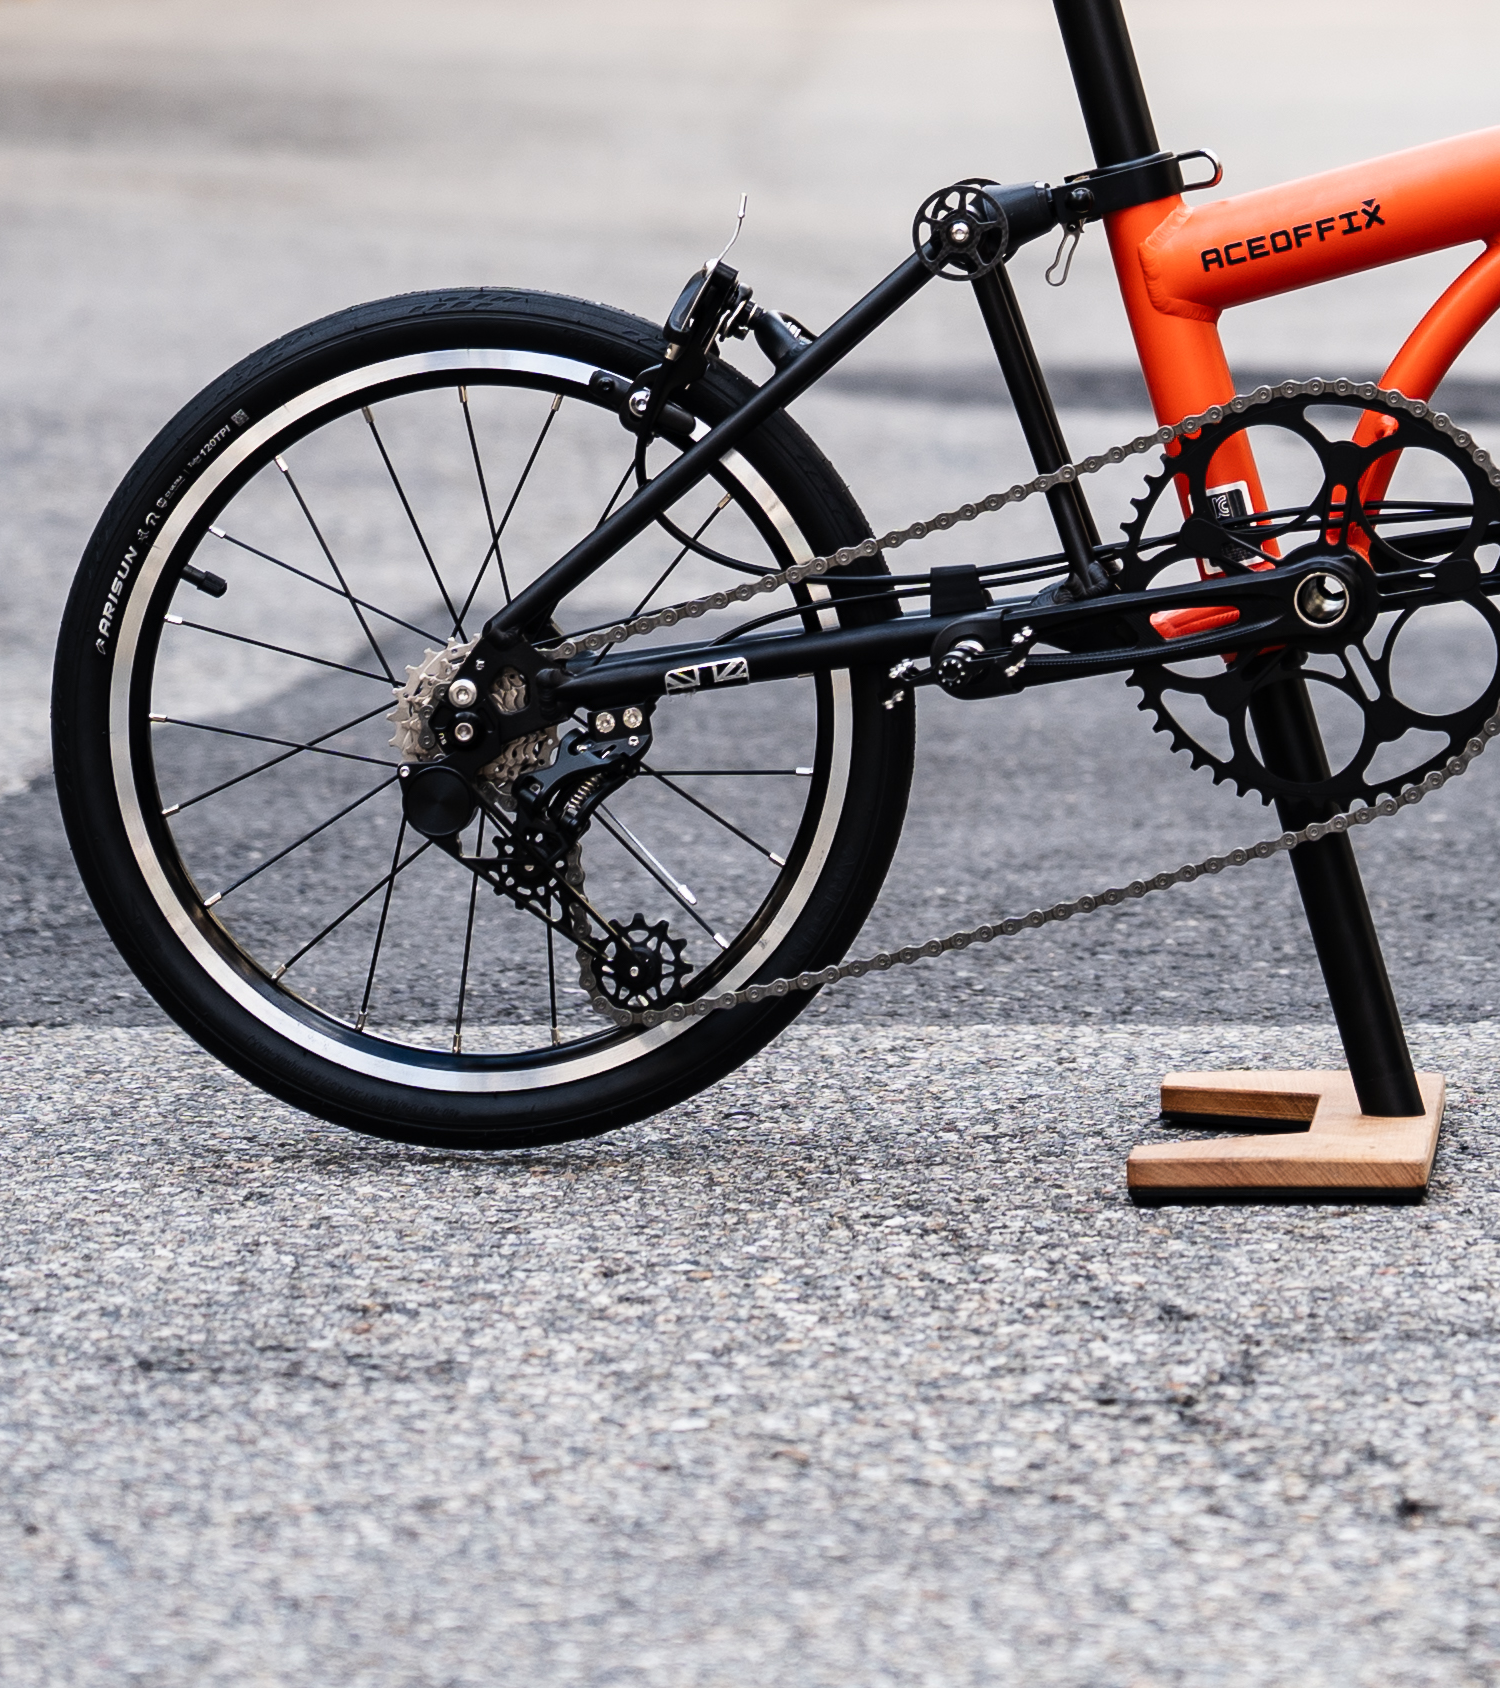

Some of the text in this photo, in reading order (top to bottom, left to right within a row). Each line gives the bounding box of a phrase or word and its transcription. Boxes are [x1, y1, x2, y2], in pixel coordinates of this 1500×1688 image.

[1200, 198, 1385, 272] ACEOFFIX
[98, 545, 138, 638] ARISUN
[200, 424, 231, 456] 120TPI
